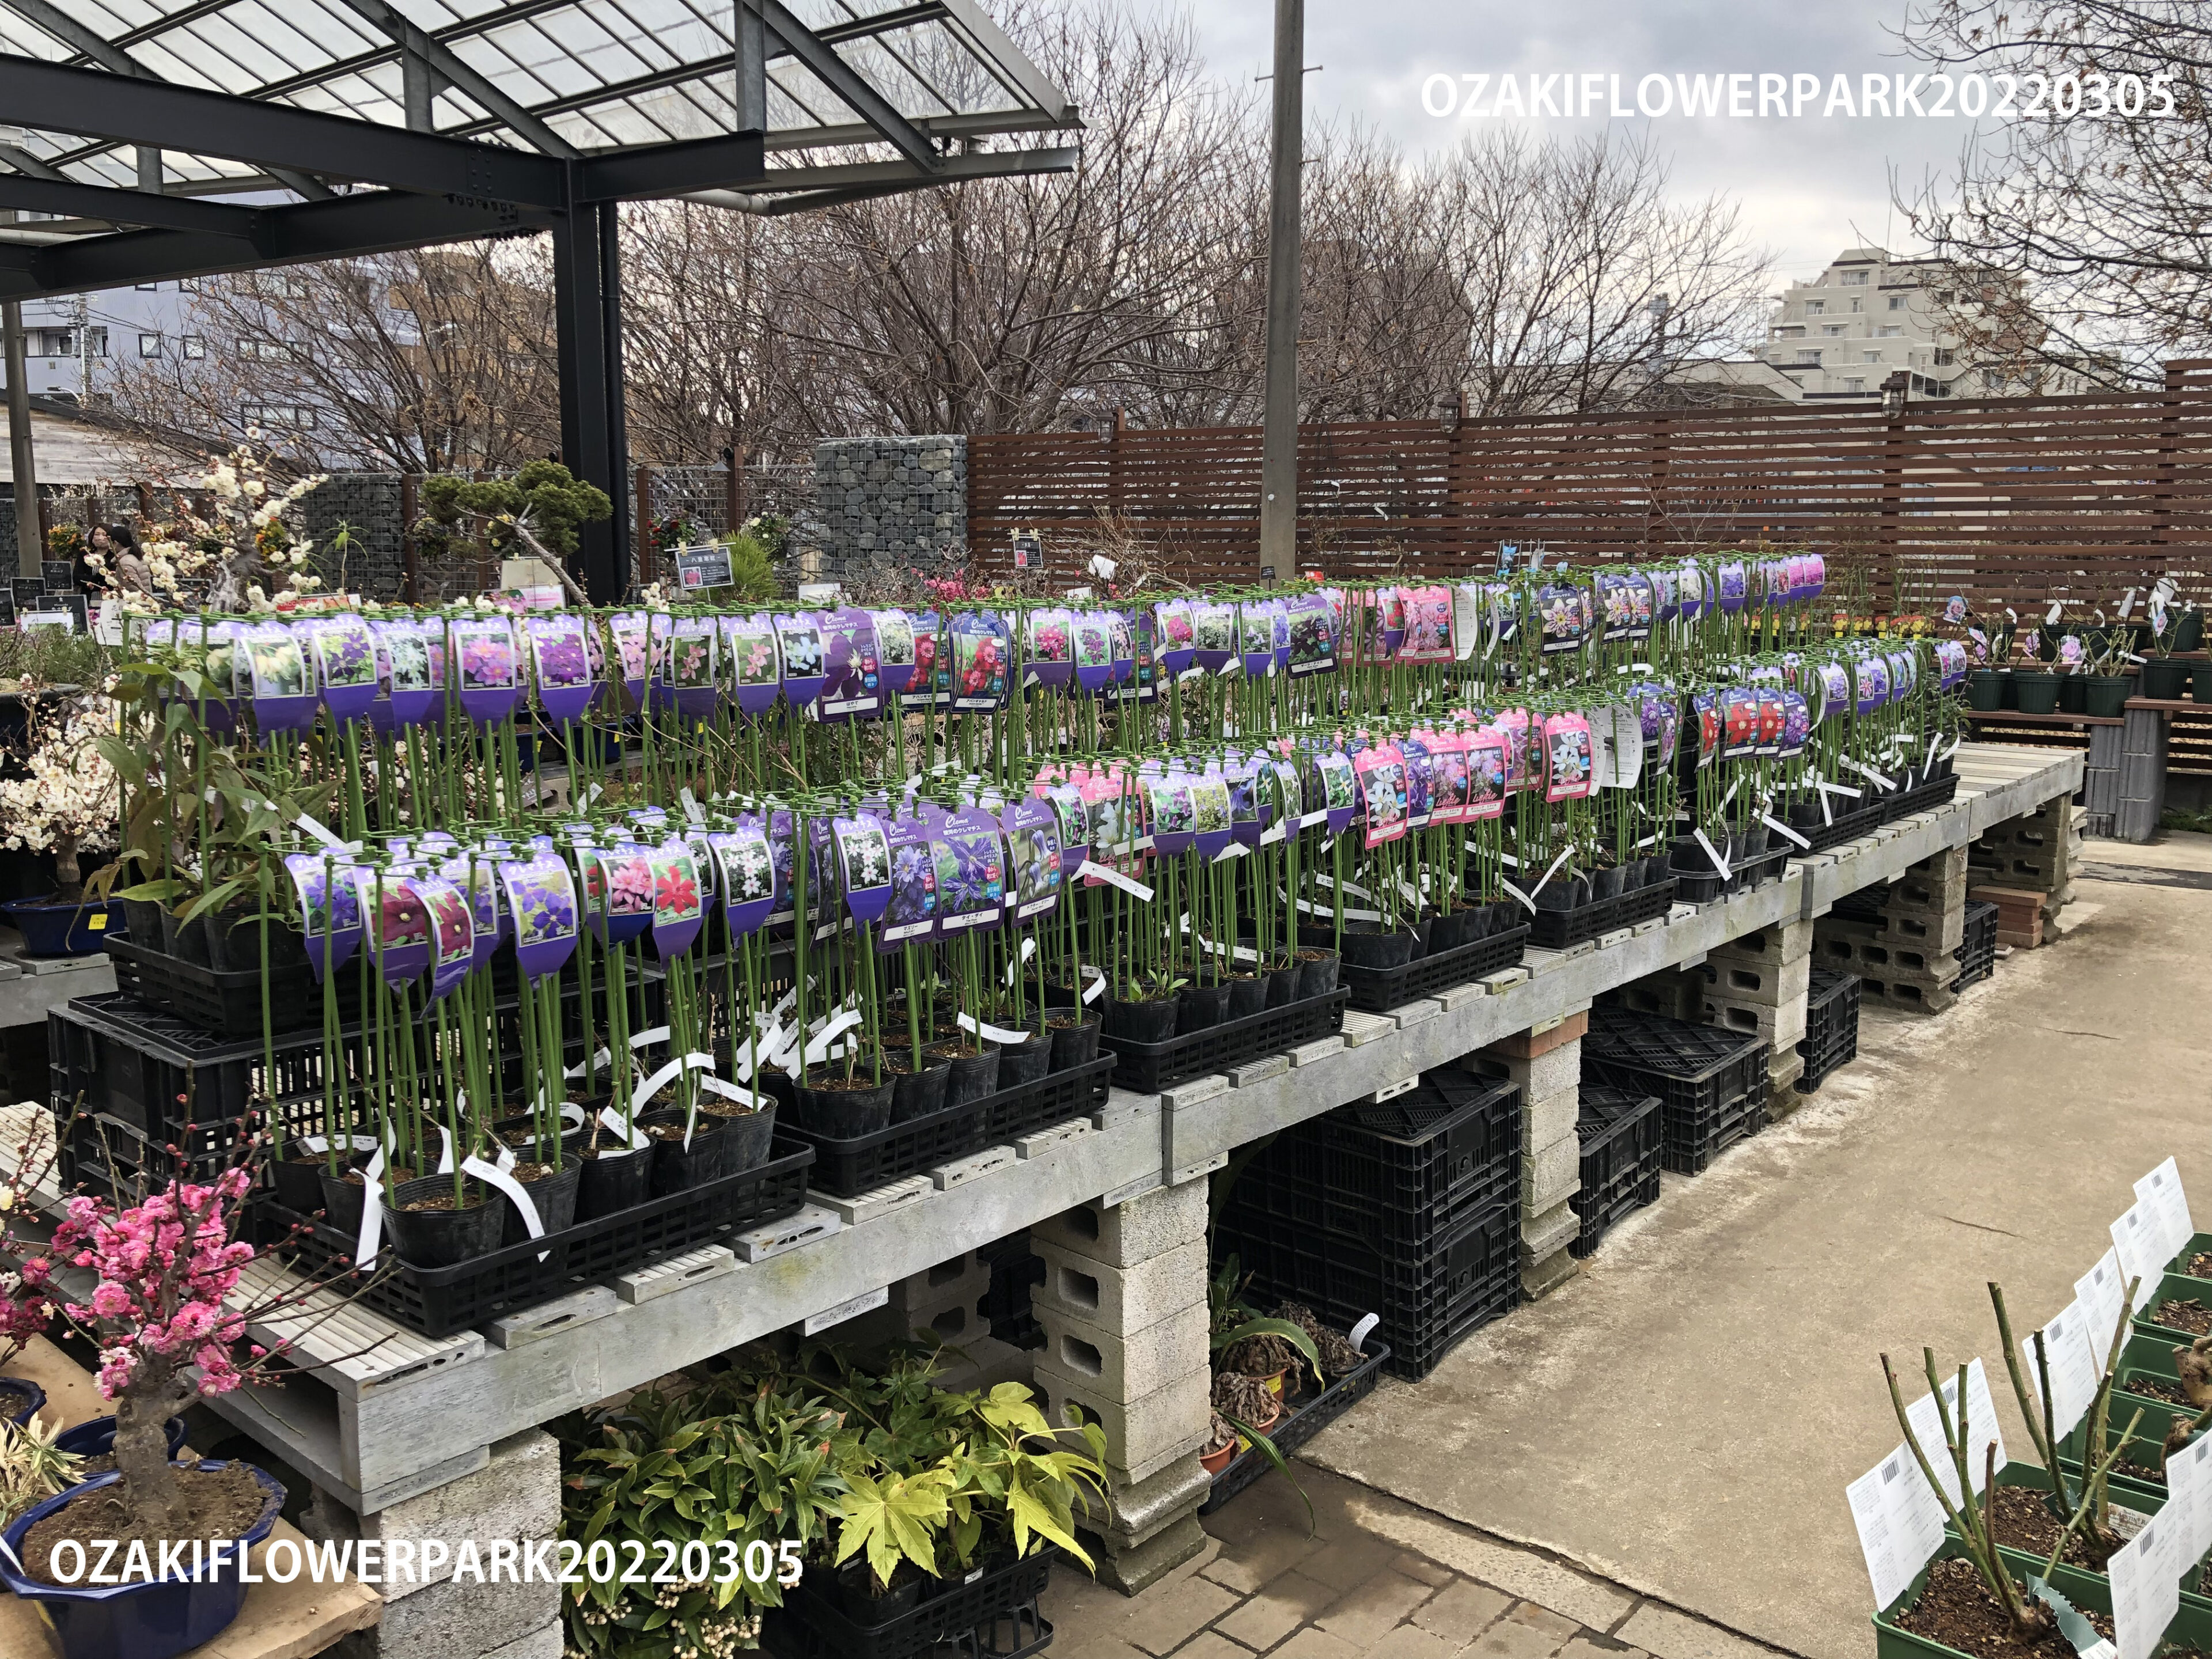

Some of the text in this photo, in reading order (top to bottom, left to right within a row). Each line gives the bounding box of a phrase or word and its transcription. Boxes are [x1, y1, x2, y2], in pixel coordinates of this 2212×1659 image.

[733, 622, 767, 631] クレマチス
[779, 617, 812, 627] クレマチス
[1191, 775, 1219, 785] クレマチス
[840, 819, 874, 832] クレマチス
[716, 830, 756, 844] クレマチス
[599, 847, 637, 857] クレマチス
[643, 844, 683, 859] クレマチス
[508, 860, 556, 876] クレマチス
